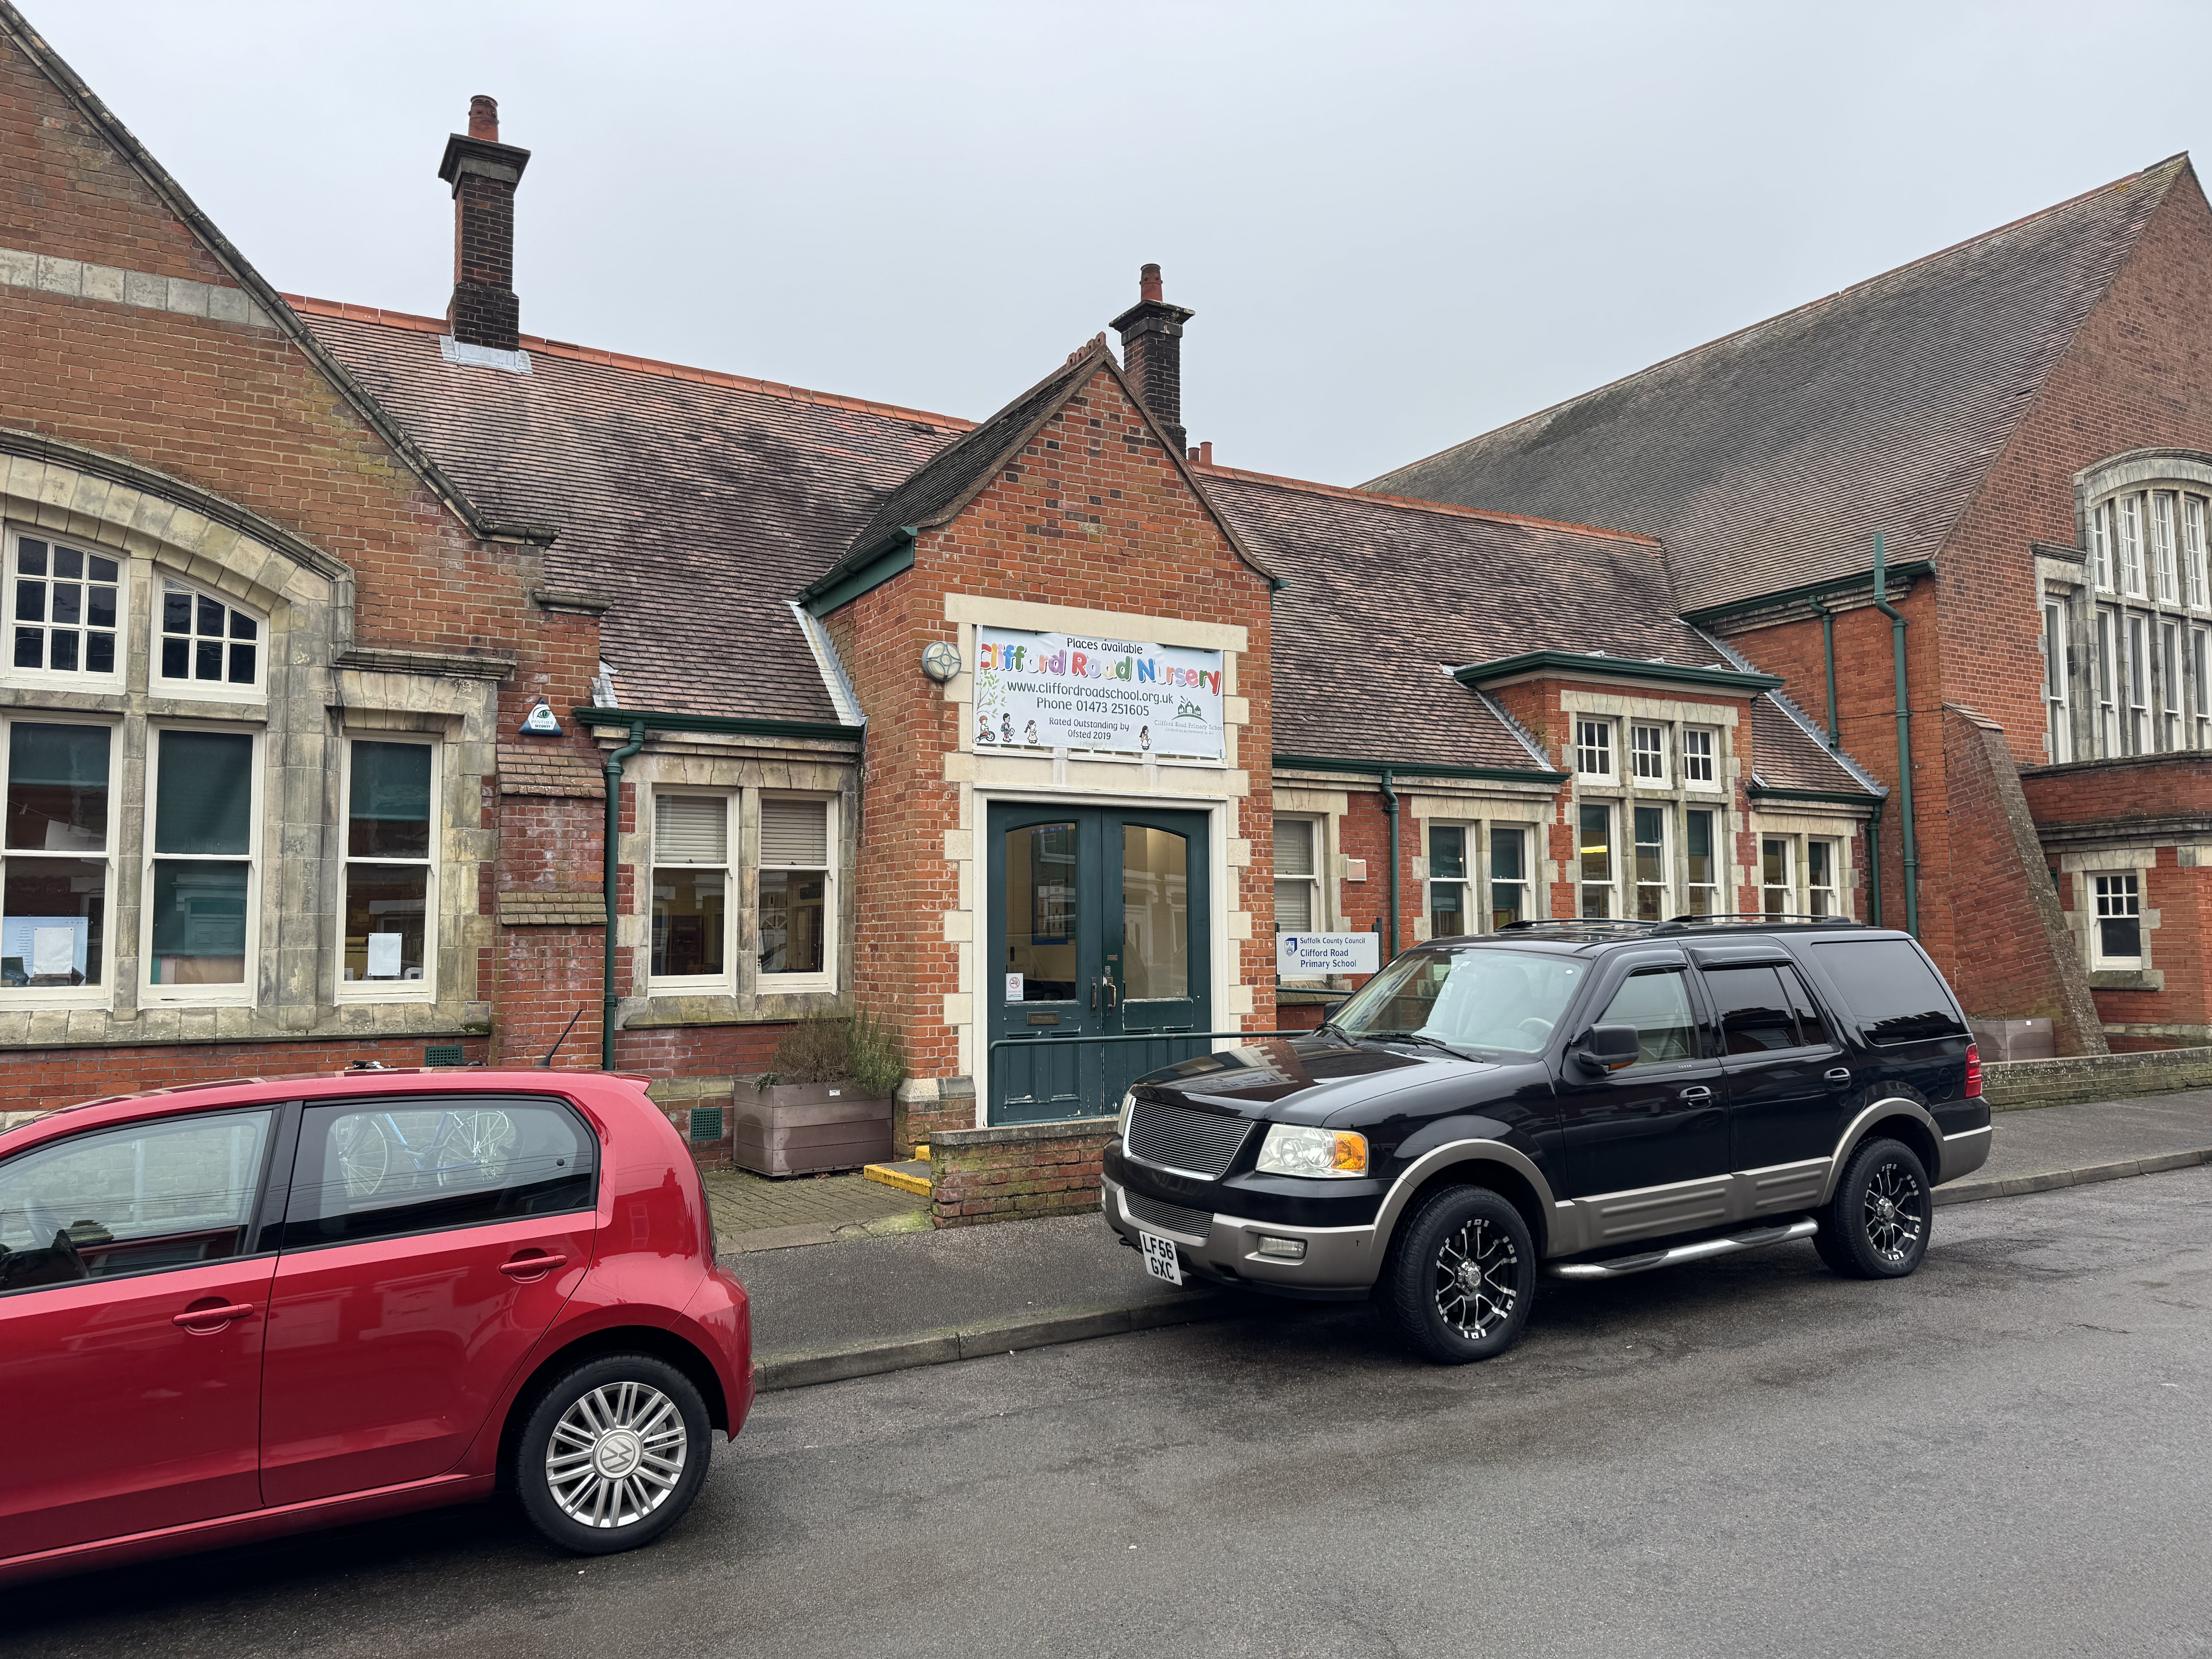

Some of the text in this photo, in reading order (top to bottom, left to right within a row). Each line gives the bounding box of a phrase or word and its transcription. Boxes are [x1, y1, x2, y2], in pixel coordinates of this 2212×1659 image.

[1067, 637, 1143, 654] Places available
[1072, 651, 1132, 682] Road
[1007, 681, 1173, 704] www.cliffordroadschool.org.uk
[1037, 697, 1149, 716] Phone 01473 251605
[1049, 717, 1130, 732] Rated Outstanding by
[1068, 729, 1111, 740] Ofsted 2019
[1300, 949, 1348, 957] Clifford Road
[1300, 959, 1357, 969] Primary School
[1142, 1234, 1174, 1261] LF56
[1151, 1257, 1175, 1280] GXC
